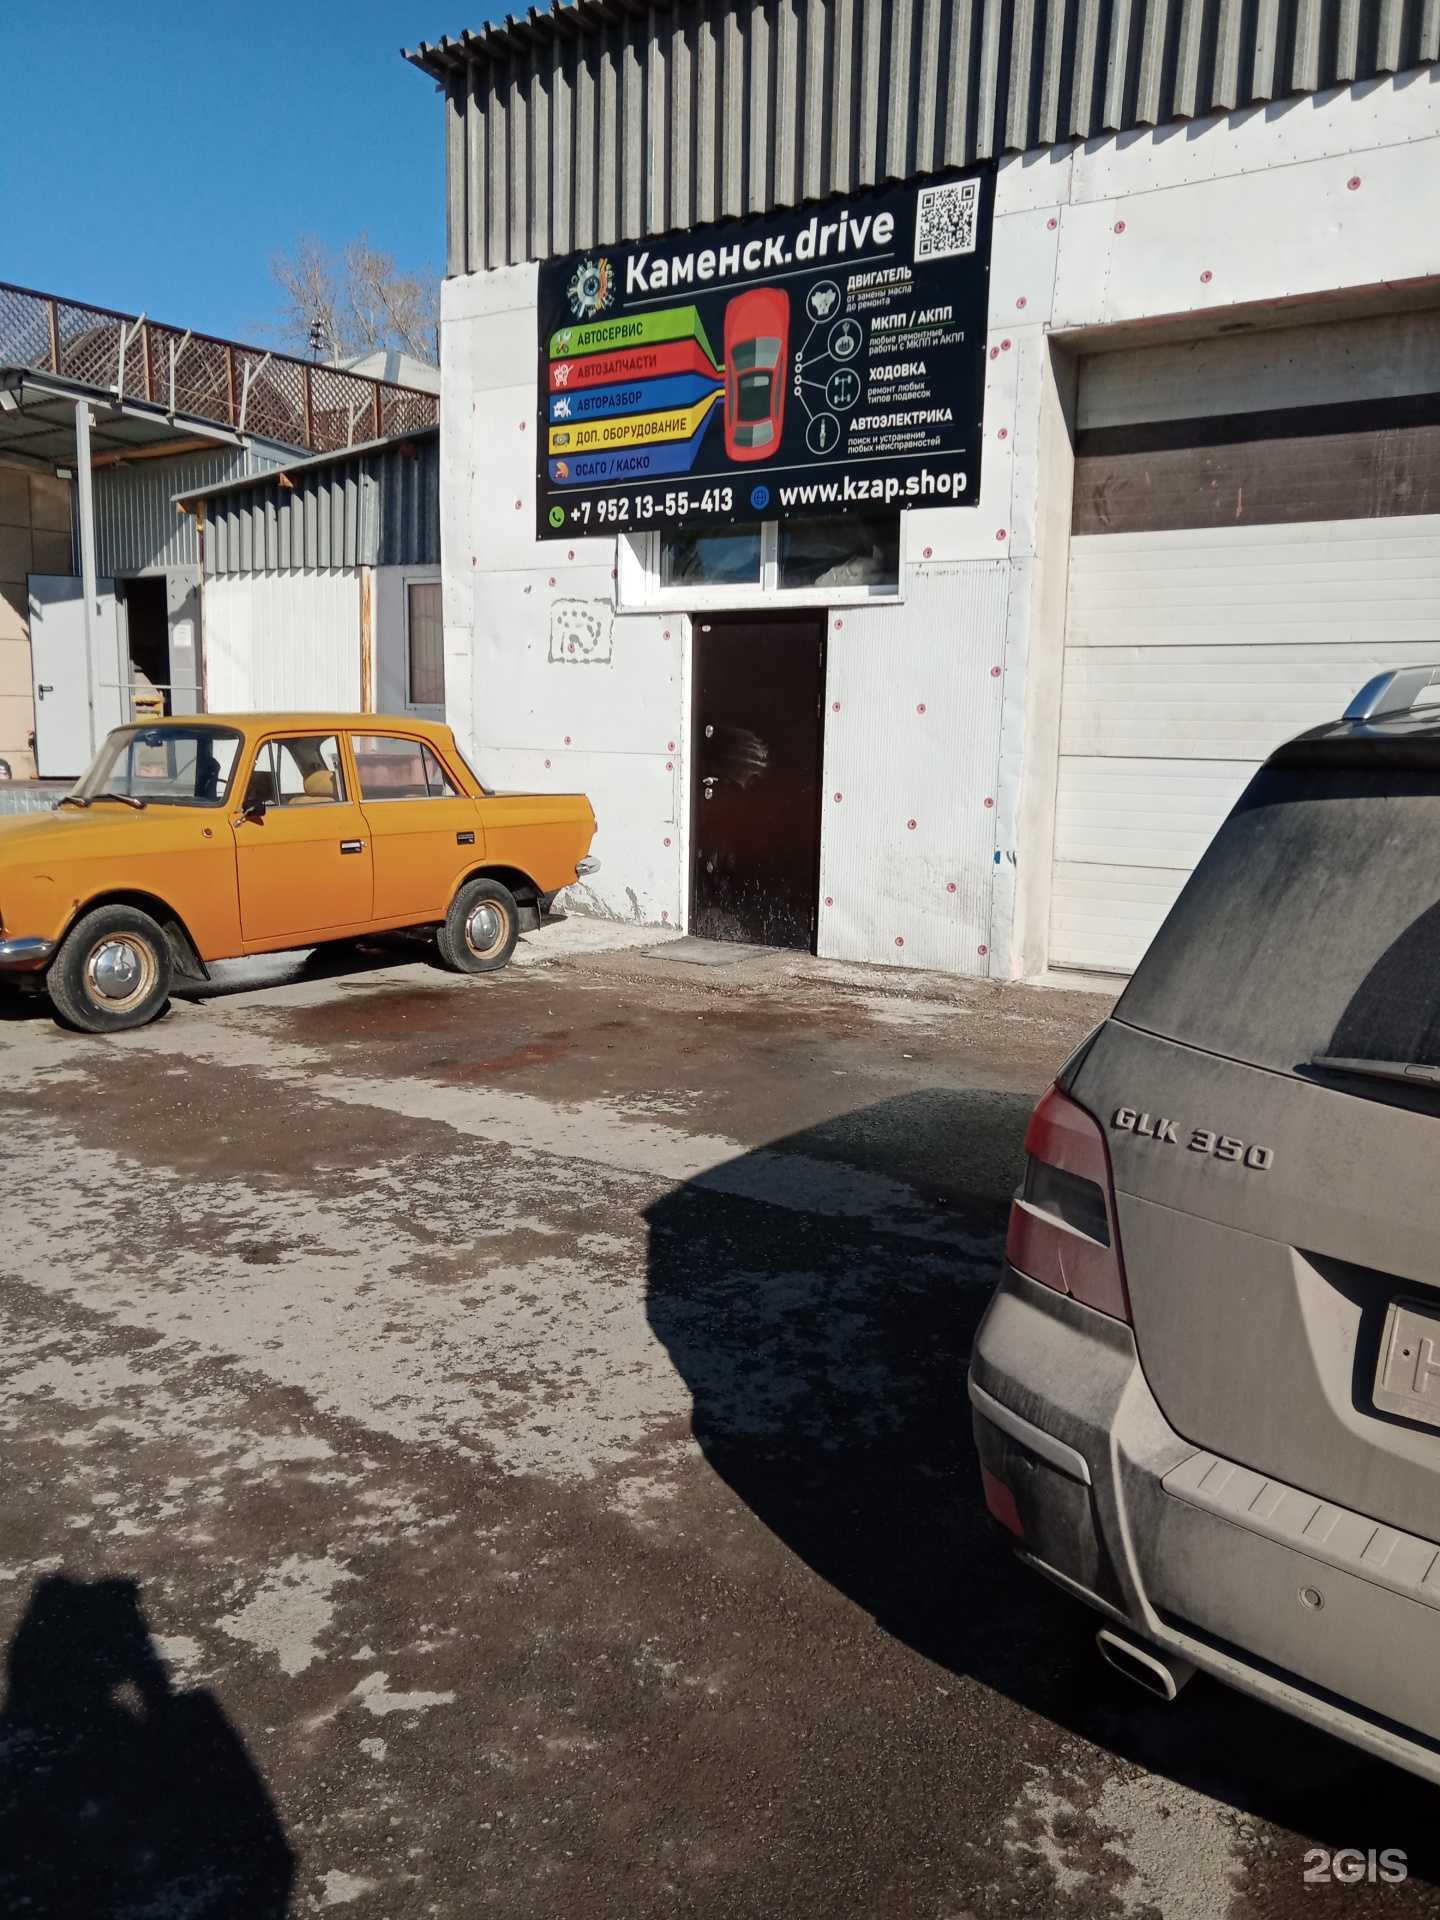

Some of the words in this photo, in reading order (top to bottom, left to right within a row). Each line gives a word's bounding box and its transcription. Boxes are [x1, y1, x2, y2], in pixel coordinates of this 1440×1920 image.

[626, 210, 895, 294] Каменск.drive
[847, 266, 912, 291] ДВИГАТЕЛЬ
[846, 303, 857, 312] до
[858, 297, 890, 311] ремонта
[847, 295, 855, 303] от
[857, 289, 886, 301] замены
[888, 285, 912, 295] масла
[871, 313, 906, 331] МКПП
[918, 306, 952, 324] АКПП
[577, 322, 643, 346] АВТОСЕРВИС
[869, 335, 896, 347] любые
[898, 328, 943, 341] ремонтные
[869, 343, 898, 356] работы
[906, 337, 931, 349] МКПП
[940, 332, 965, 345] АКПП
[577, 355, 657, 379] АВТОЗАПЧАСТИ
[869, 361, 926, 381] ХОДОВКА
[868, 386, 896, 397] ремонт
[898, 382, 925, 392] любых
[868, 395, 890, 404] типов
[893, 390, 931, 402] подвесок
[577, 391, 642, 412] АВТОРАЗБОР
[849, 408, 953, 431] АВТОЭЛЕКТРИКА
[576, 430, 600, 446] ДОП.
[603, 417, 687, 441] ОБОРУДОВАНИЕ
[848, 436, 870, 446] поиск
[880, 431, 926, 443] устранение
[848, 443, 874, 454] любых
[875, 435, 941, 450] неисправностей
[576, 462, 606, 477] ОСАГО
[617, 456, 650, 473] КАСКО
[779, 469, 967, 506] www.kzap.shop
[571, 502, 591, 524] +7
[597, 498, 629, 522] 952
[635, 487, 732, 519] 13-55-413
[1112, 1107, 1180, 1144] GLK
[1188, 1129, 1274, 1170] 350
